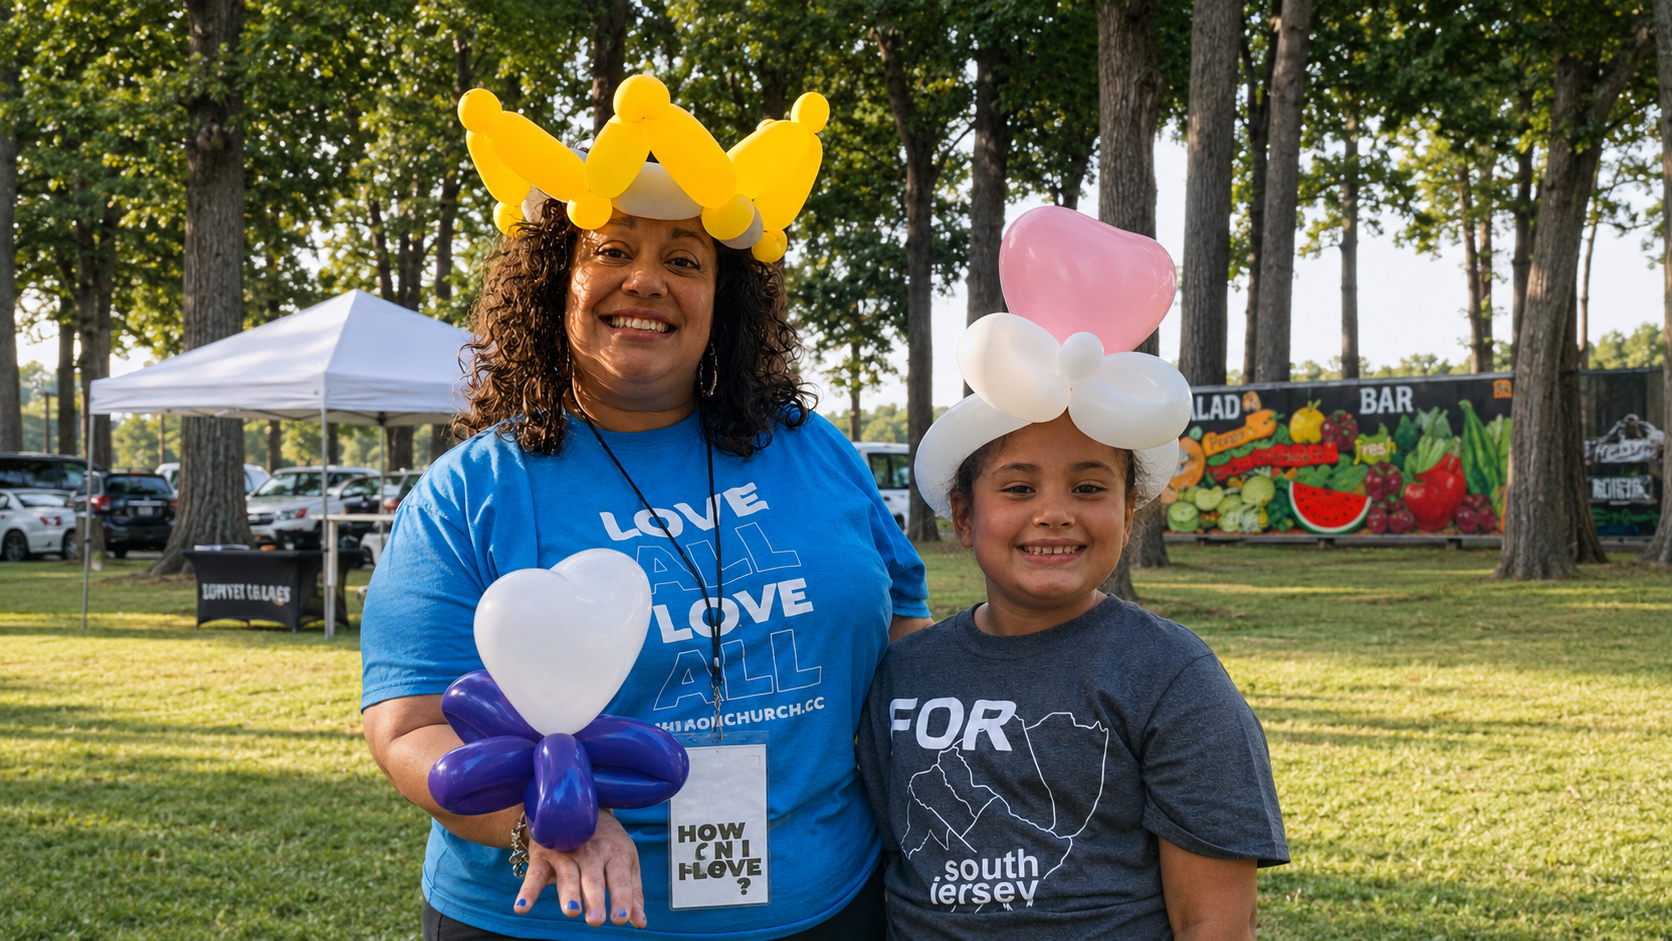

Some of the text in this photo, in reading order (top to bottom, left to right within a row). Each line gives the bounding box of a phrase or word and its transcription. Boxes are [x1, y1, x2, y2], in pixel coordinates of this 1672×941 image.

[1360, 386, 1414, 414] BAR
[599, 482, 769, 541] LOVE
[637, 522, 801, 594] ALL
[652, 578, 814, 643] LOVE
[653, 629, 821, 711] ALL
[889, 697, 1013, 754] FOR
[678, 822, 746, 843] HOW
[944, 848, 1039, 882] south
